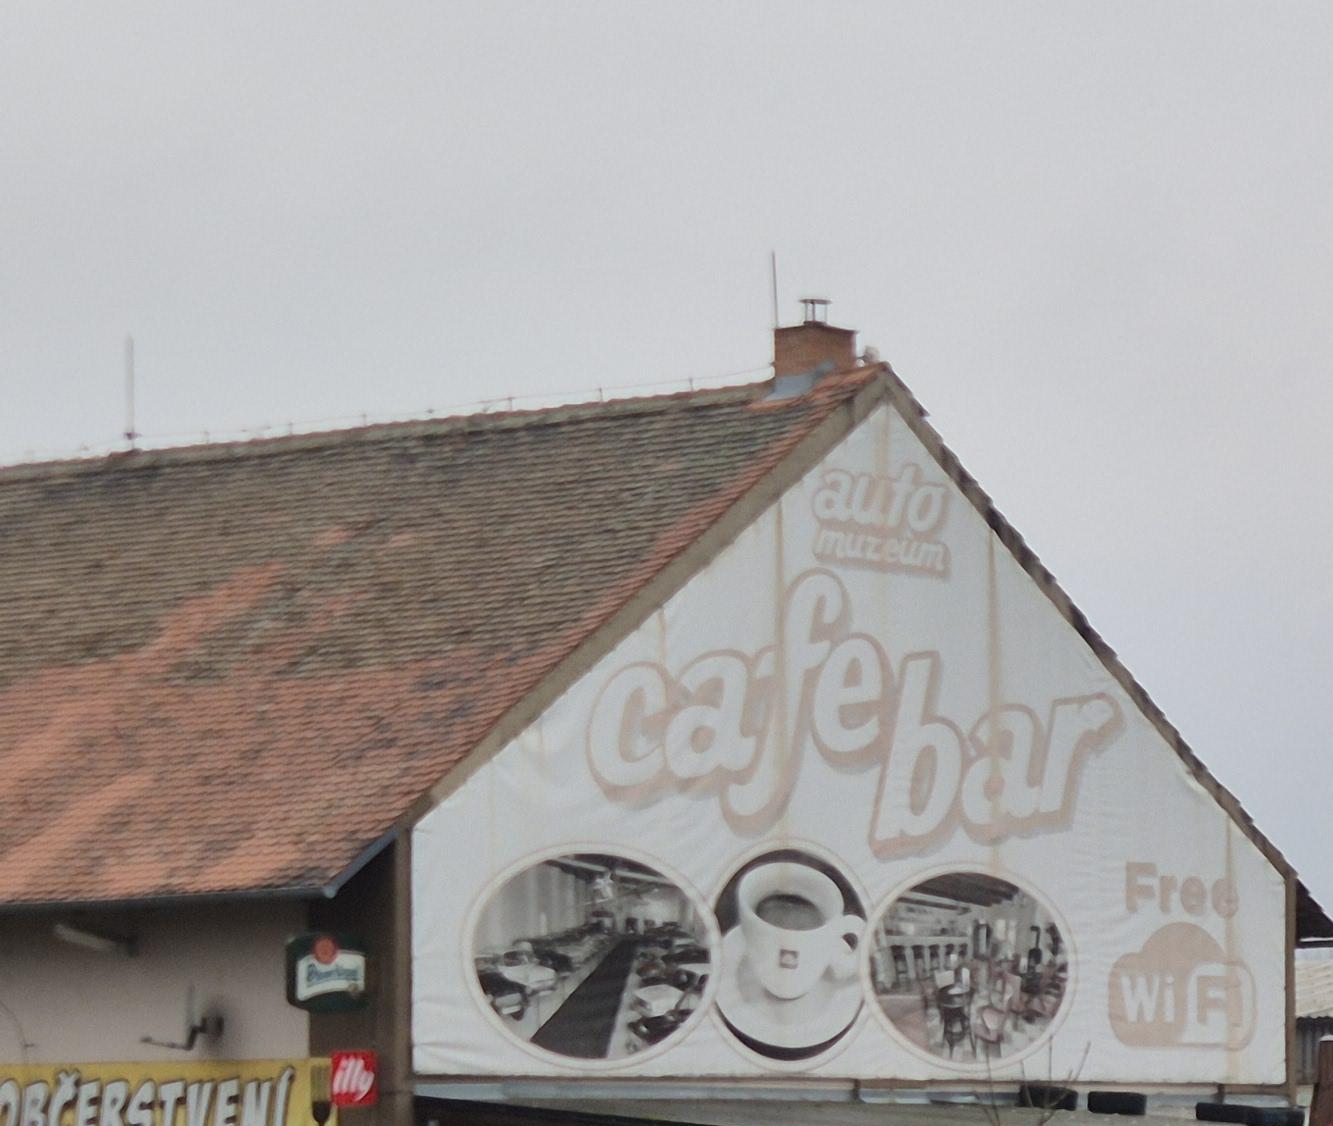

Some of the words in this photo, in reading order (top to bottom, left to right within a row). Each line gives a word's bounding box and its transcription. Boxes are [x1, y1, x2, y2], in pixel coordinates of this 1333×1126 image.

[815, 465, 947, 530] auto
[814, 529, 949, 574] muzeum
[588, 569, 887, 834] cafe
[870, 652, 1123, 858] bar
[1124, 860, 1239, 921] Free
[333, 1055, 376, 1102] illy
